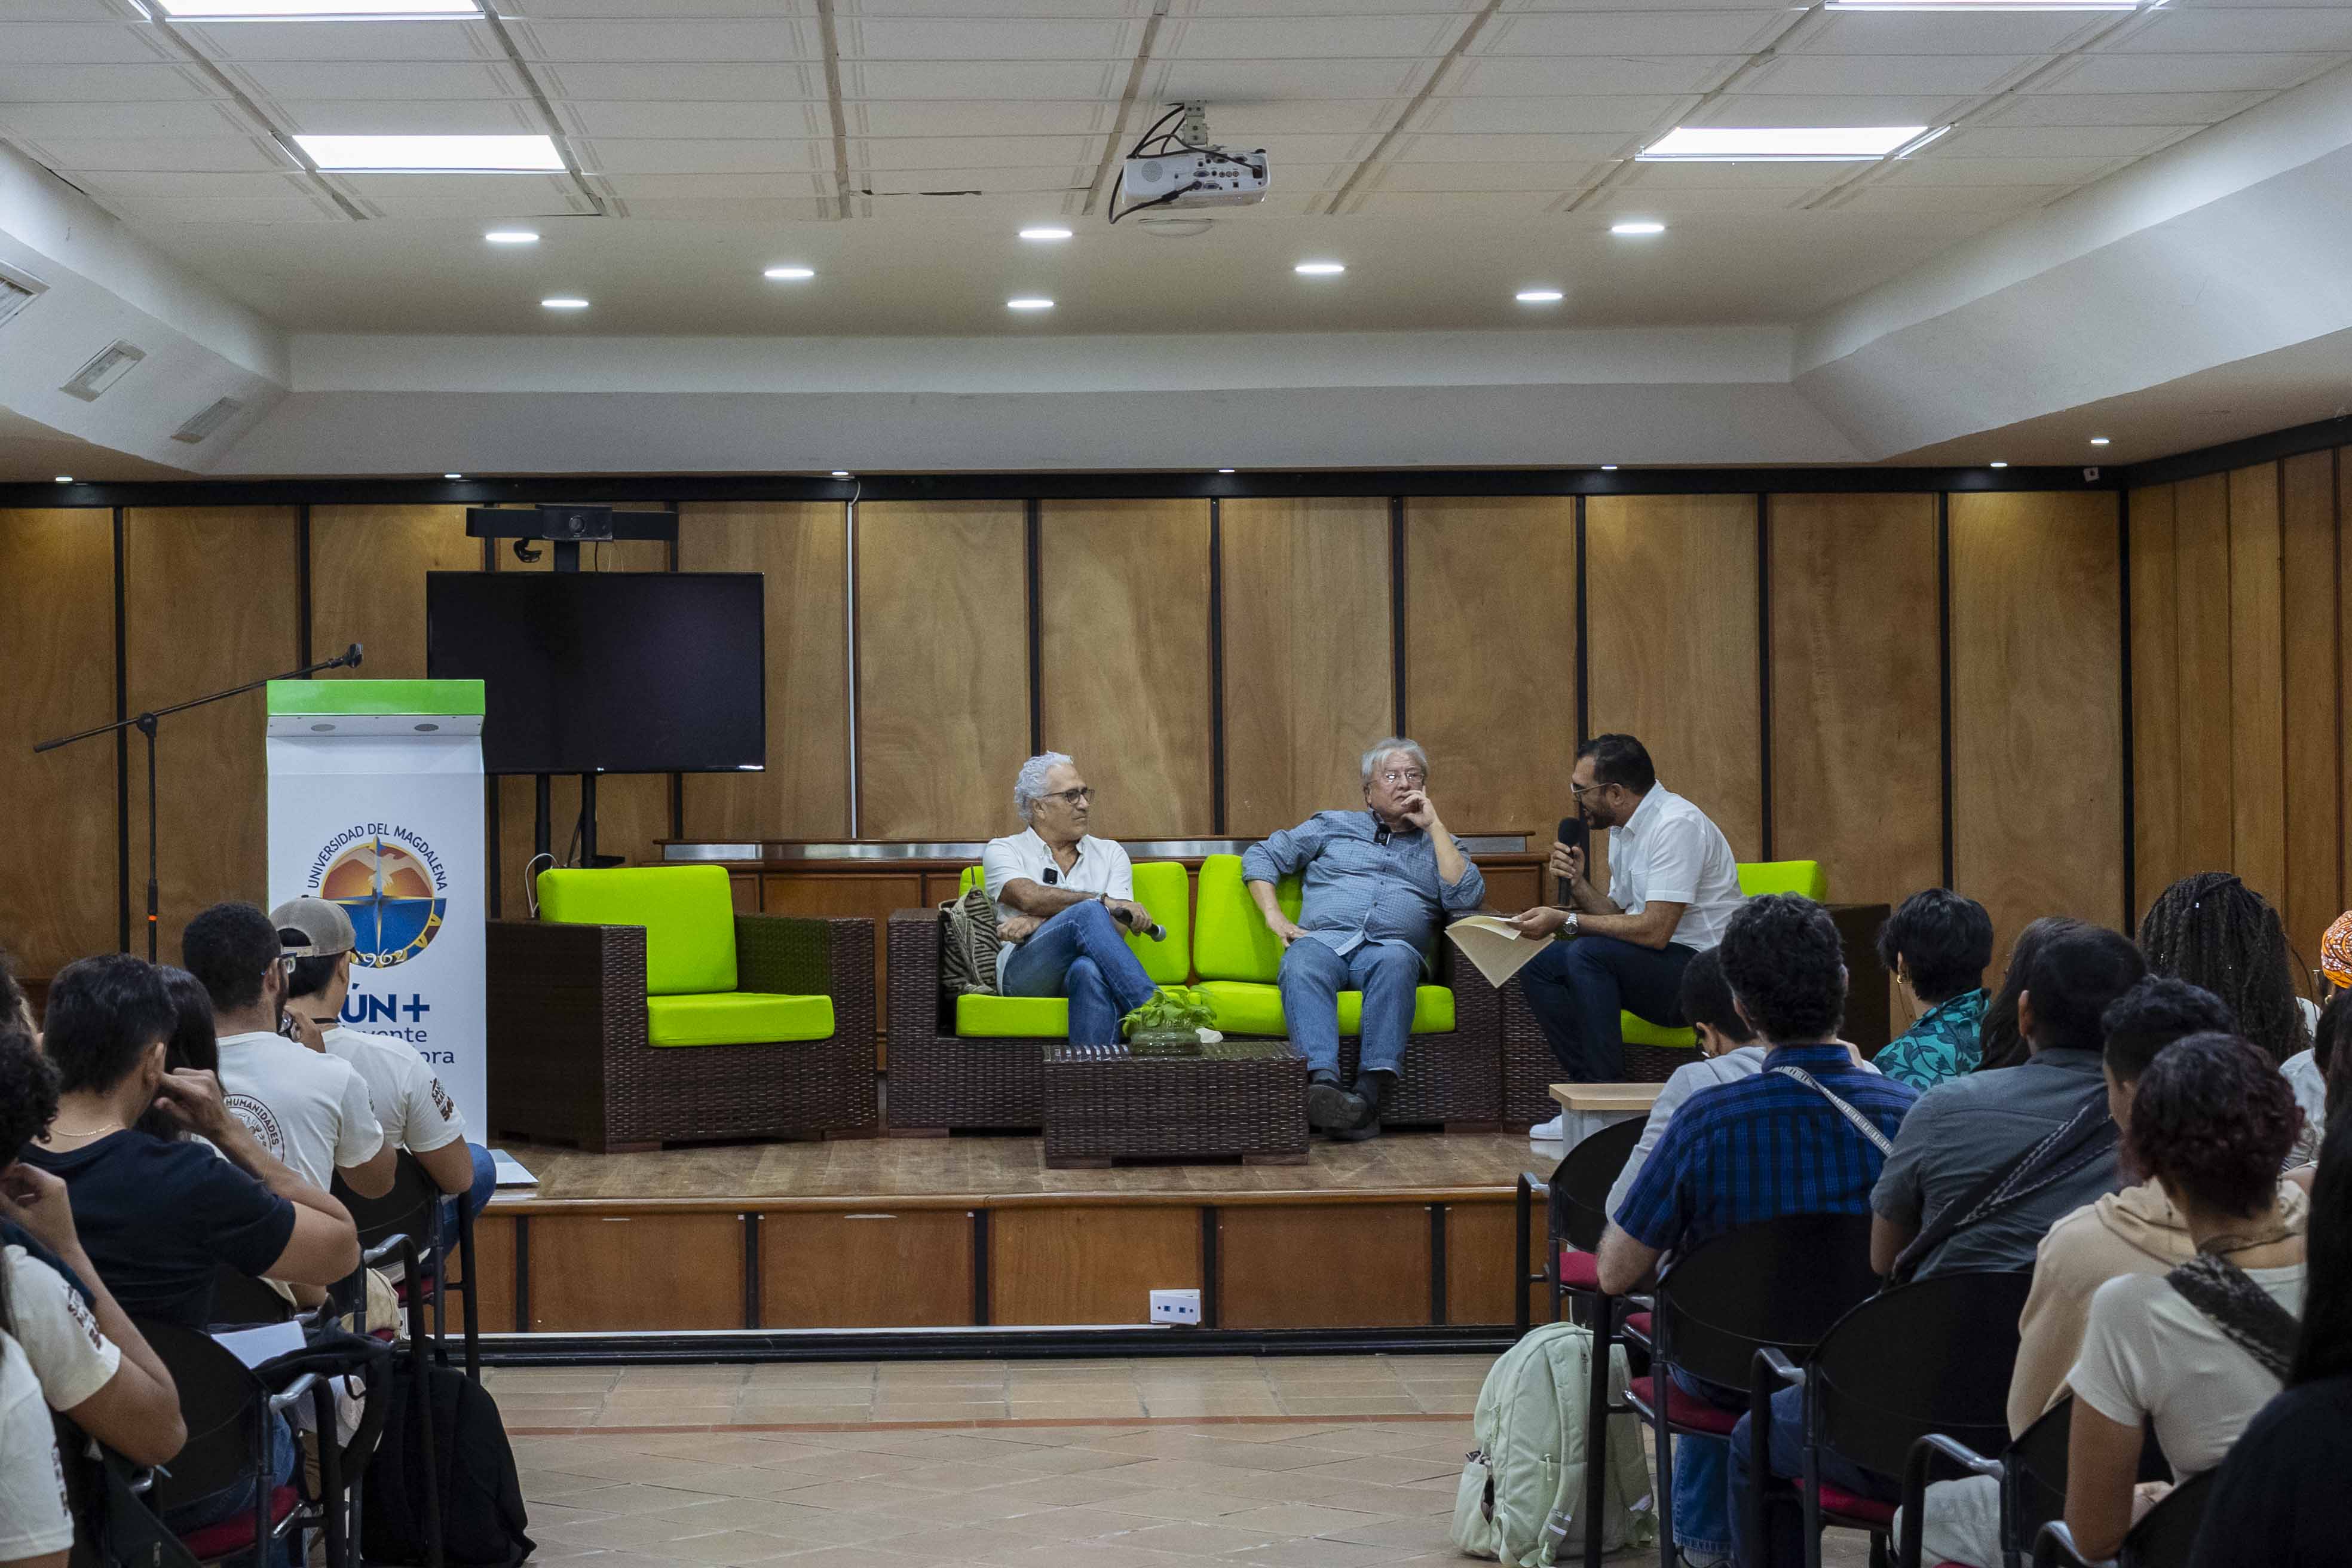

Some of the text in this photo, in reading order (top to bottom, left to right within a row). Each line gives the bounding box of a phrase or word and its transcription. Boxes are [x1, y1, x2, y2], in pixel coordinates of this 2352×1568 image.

[307, 822, 448, 891] UNIVERSIDAD DEL MAGDALENA
[225, 1098, 280, 1146] HUMANIDADES
